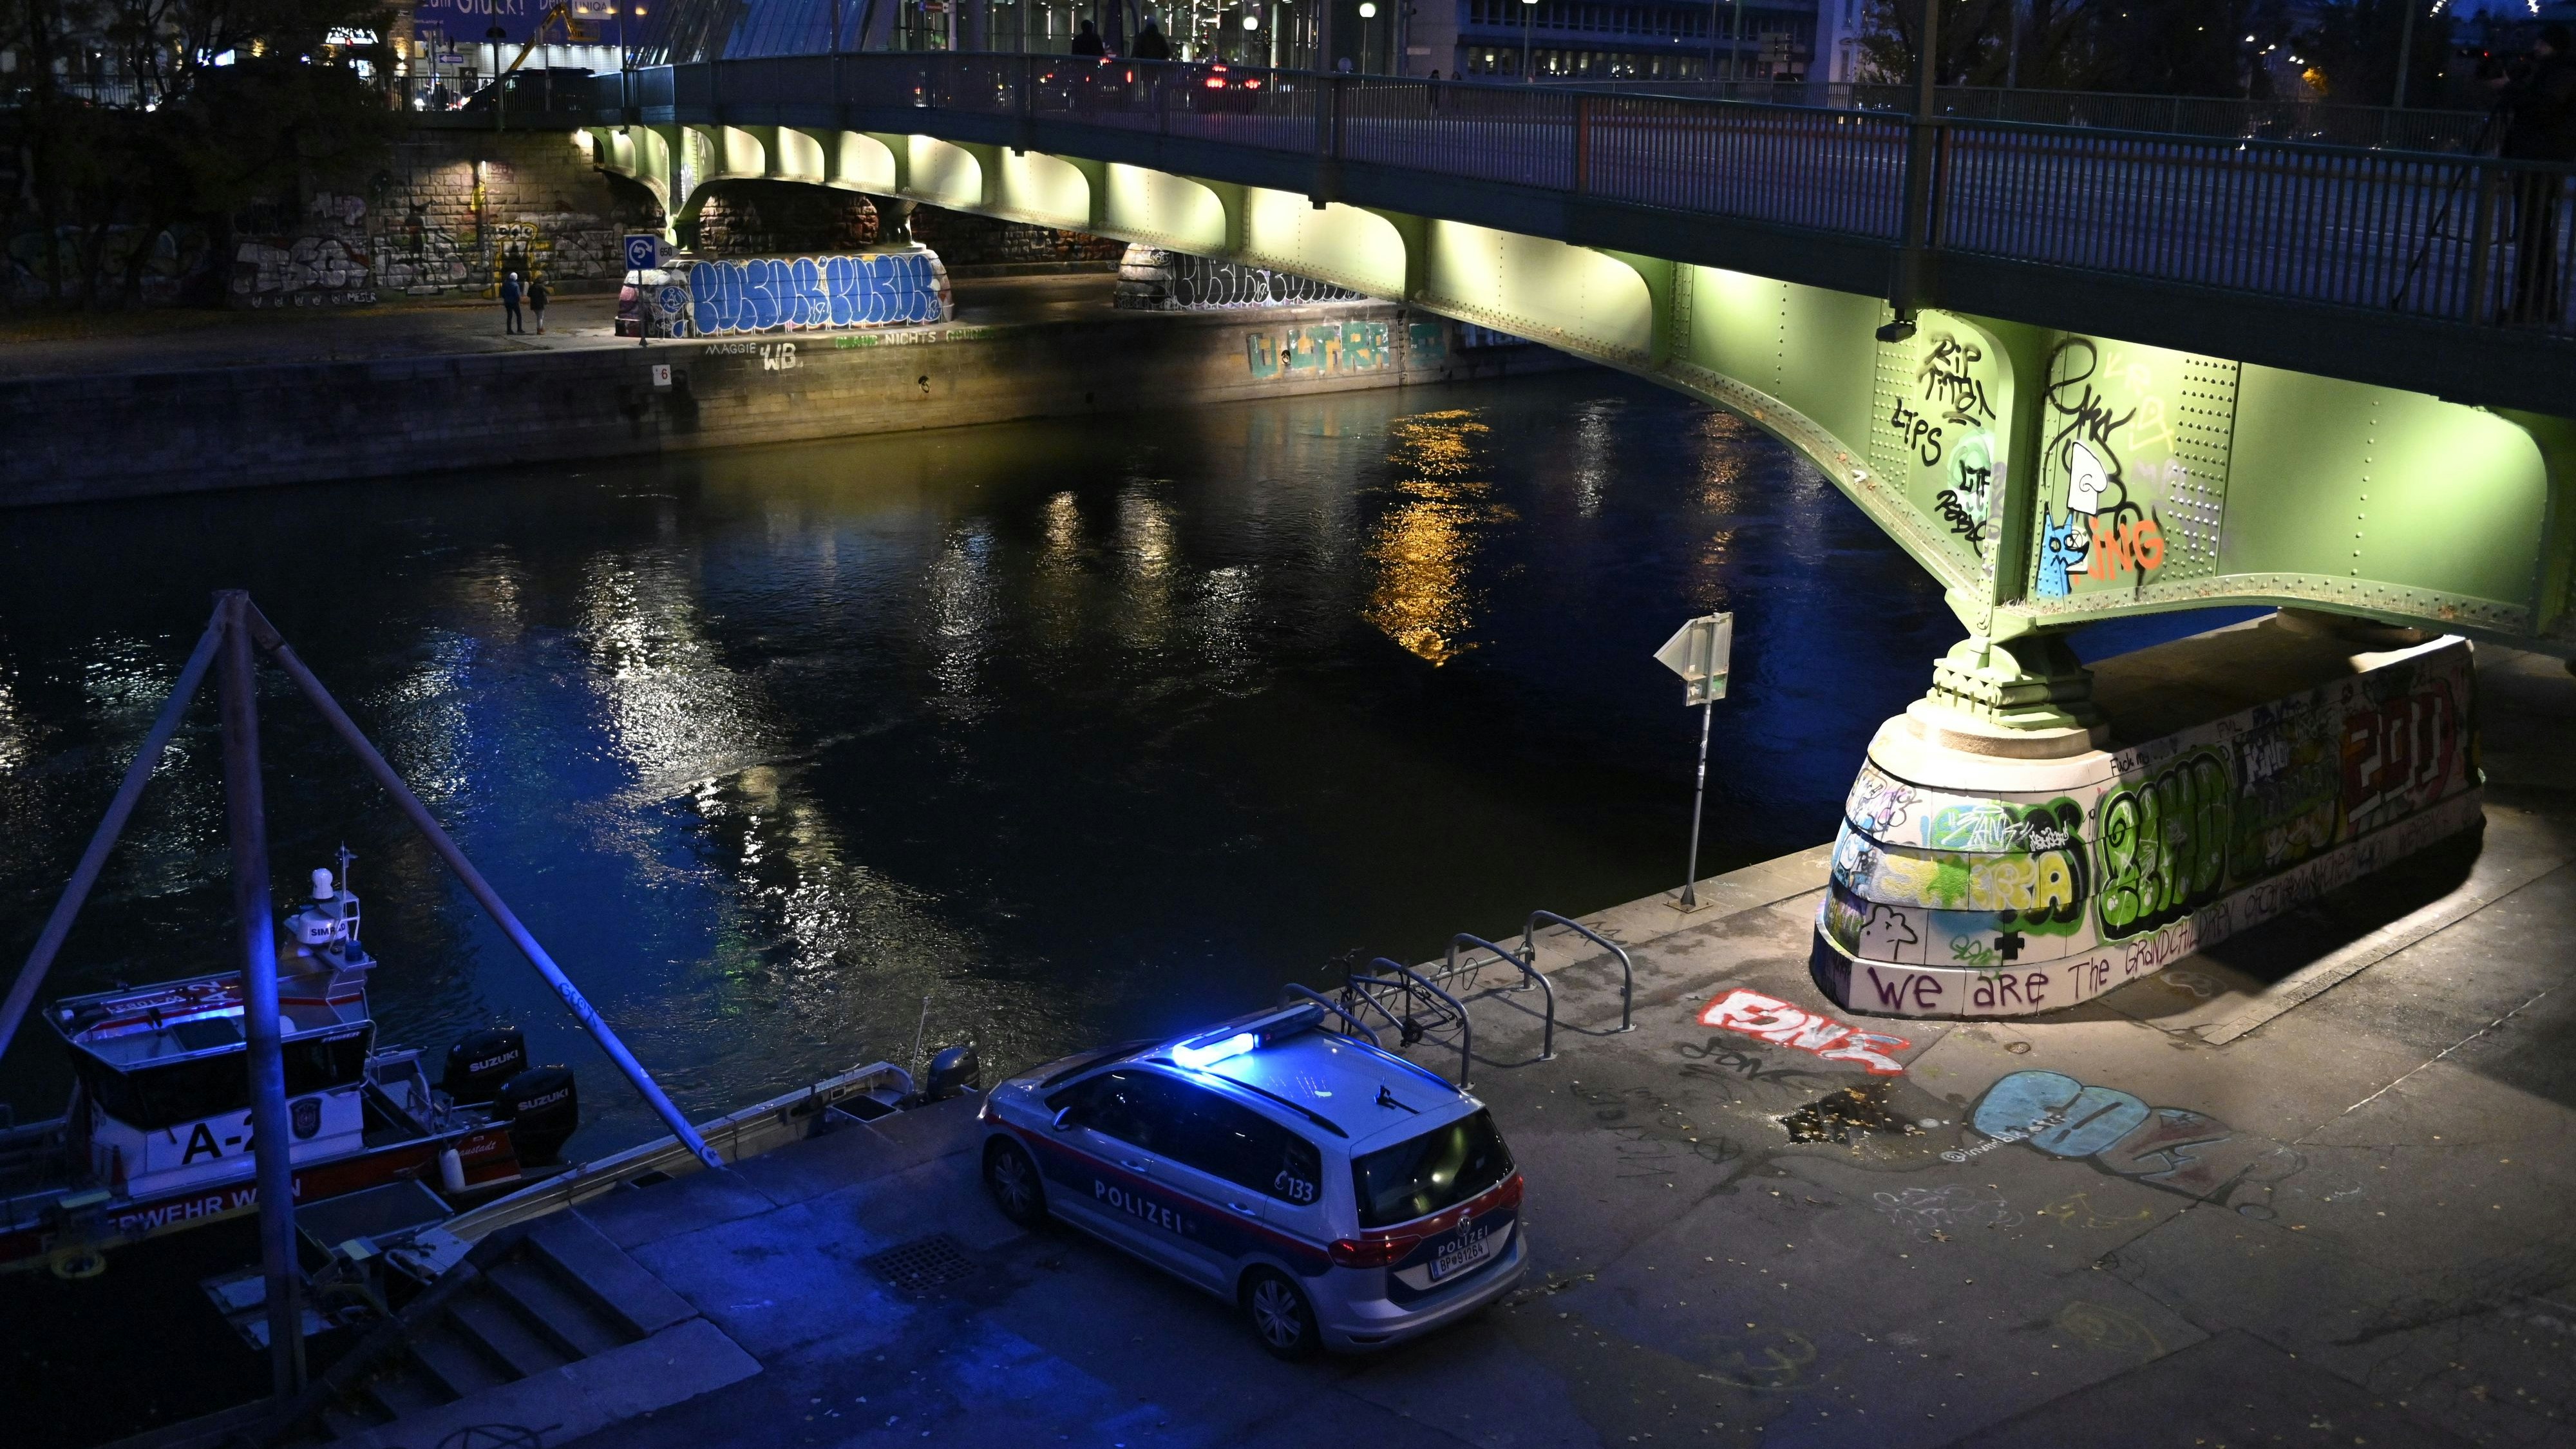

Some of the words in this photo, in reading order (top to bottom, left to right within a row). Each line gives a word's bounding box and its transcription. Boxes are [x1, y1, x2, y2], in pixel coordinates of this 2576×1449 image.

[660, 247, 672, 256] 650
[706, 343, 757, 354] MAGGIE
[885, 332, 936, 345] NICHTS
[661, 368, 668, 380] 6
[469, 1049, 519, 1072] SUZUKI
[518, 1088, 569, 1111] SUZUKI
[460, 1140, 497, 1156] austadt
[1288, 1177, 1314, 1202] 133
[1095, 1179, 1182, 1234] POLIZEI
[1438, 1225, 1488, 1257] POLIZEI
[1440, 1256, 1451, 1271] BP
[1457, 1243, 1484, 1264] 91264
